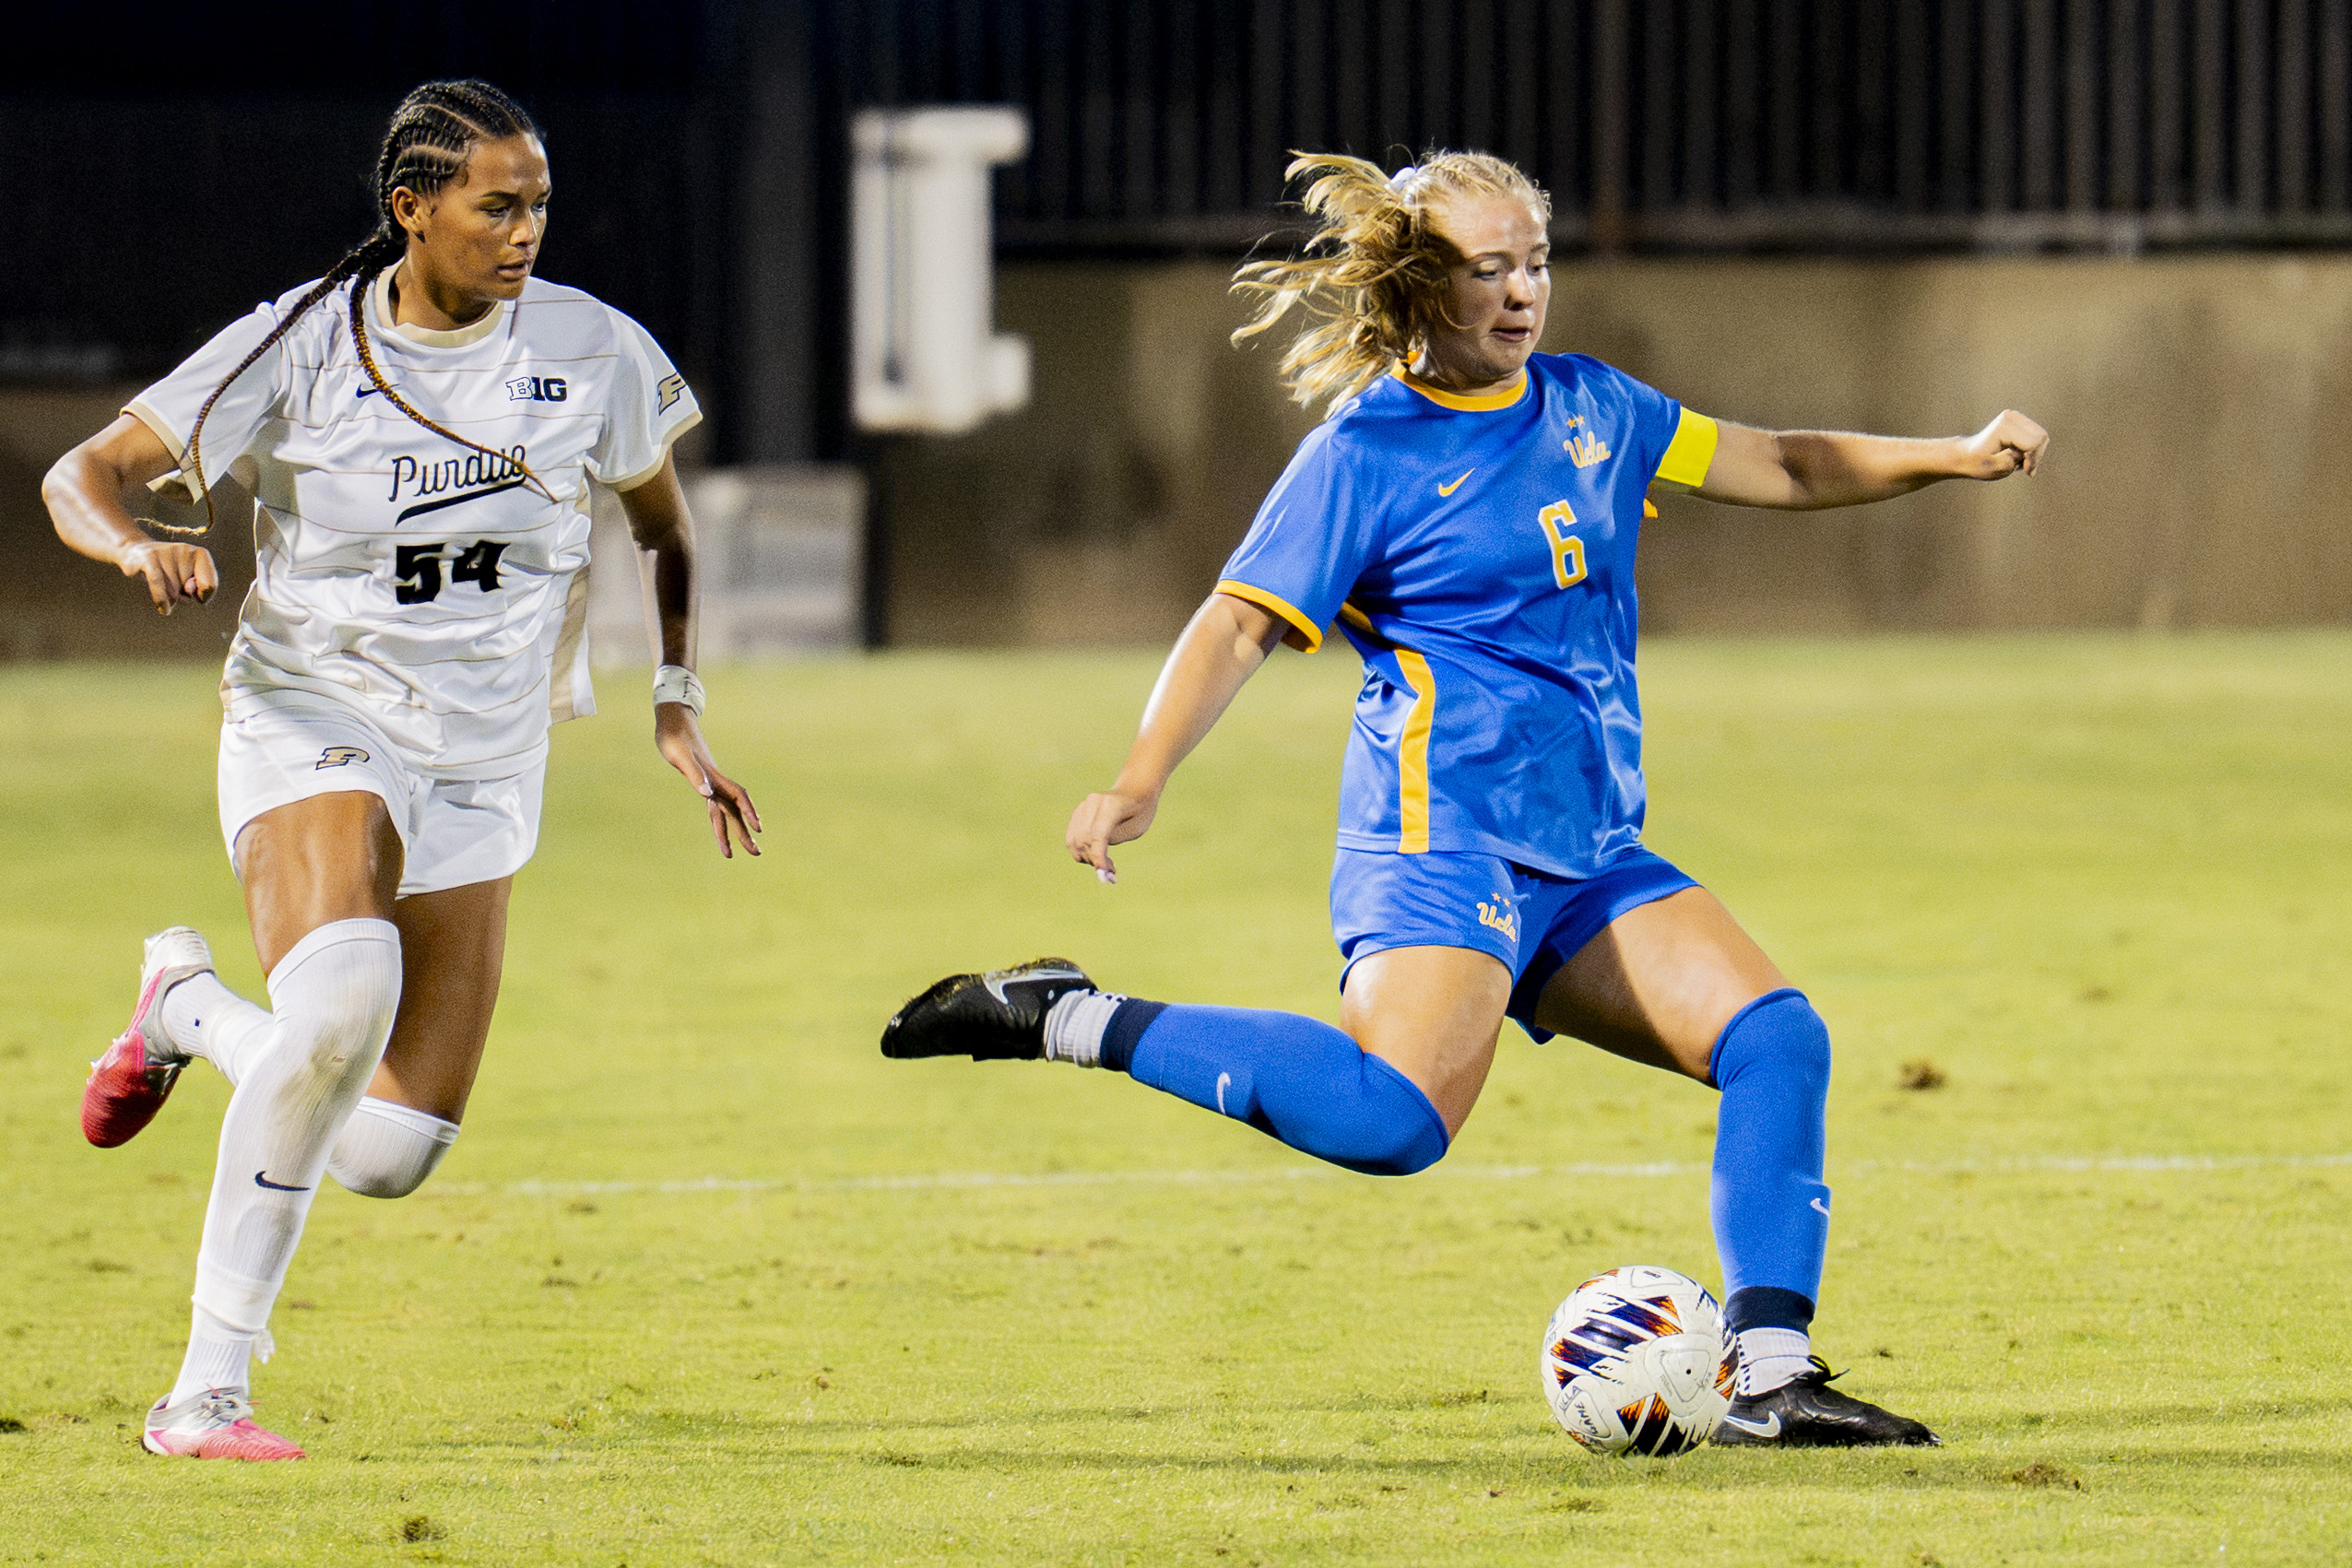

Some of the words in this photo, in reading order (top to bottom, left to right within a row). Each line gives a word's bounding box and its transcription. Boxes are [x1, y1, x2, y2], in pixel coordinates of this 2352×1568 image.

[388, 444, 526, 501] Purdue
[396, 540, 511, 606] 54
[1538, 499, 1588, 590] 6
